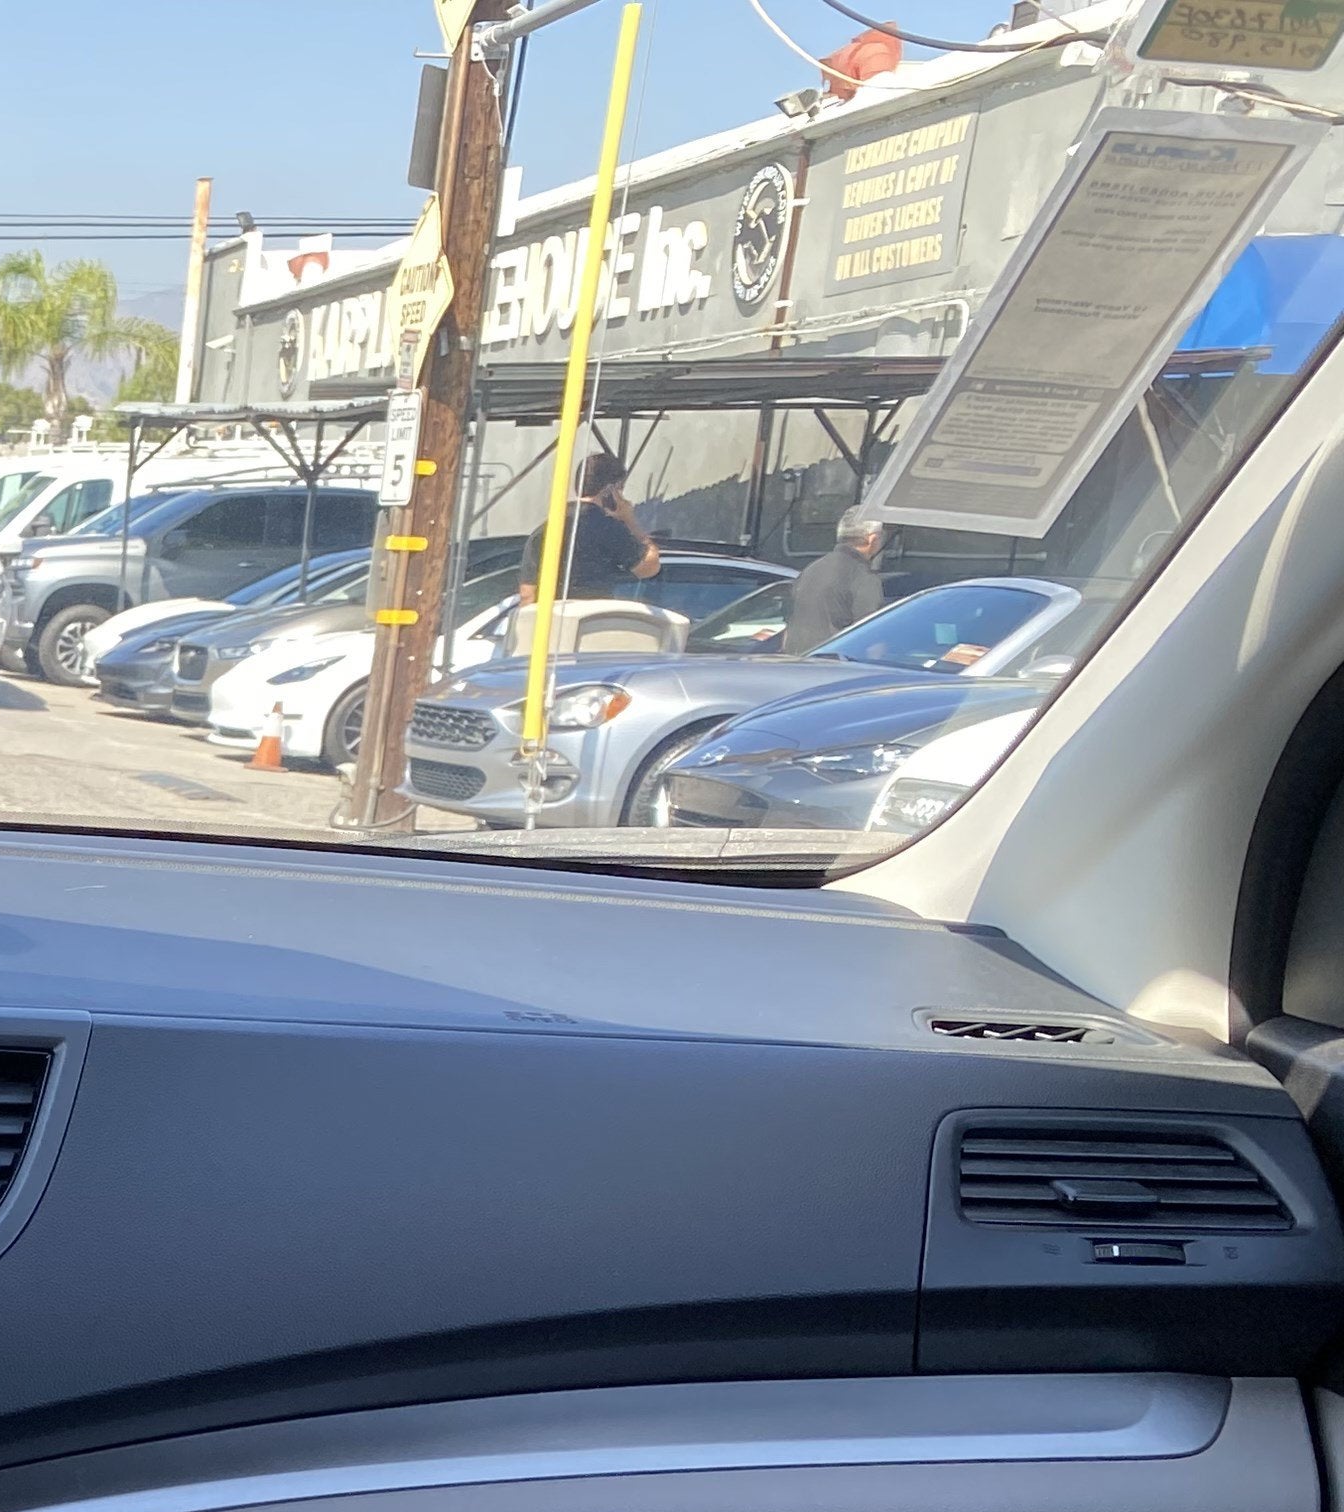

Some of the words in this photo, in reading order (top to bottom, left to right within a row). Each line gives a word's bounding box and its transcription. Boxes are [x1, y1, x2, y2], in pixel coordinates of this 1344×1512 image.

[844, 131, 910, 174] INSURANCE
[908, 114, 972, 157] COMPANY
[842, 172, 896, 208] REQUIRES
[894, 170, 905, 196] A
[906, 160, 940, 193] COPY
[940, 155, 959, 184] OF
[893, 196, 944, 232] LICENSE
[638, 205, 712, 312] Inc.
[834, 254, 852, 281] ON
[851, 249, 871, 279] ALL
[872, 234, 943, 273] CUSTOMERS
[400, 262, 437, 296] CAUTION
[401, 300, 426, 326] SPEED
[391, 408, 416, 421] SPEED
[391, 426, 412, 442] LIMIT
[392, 454, 406, 486] 5
